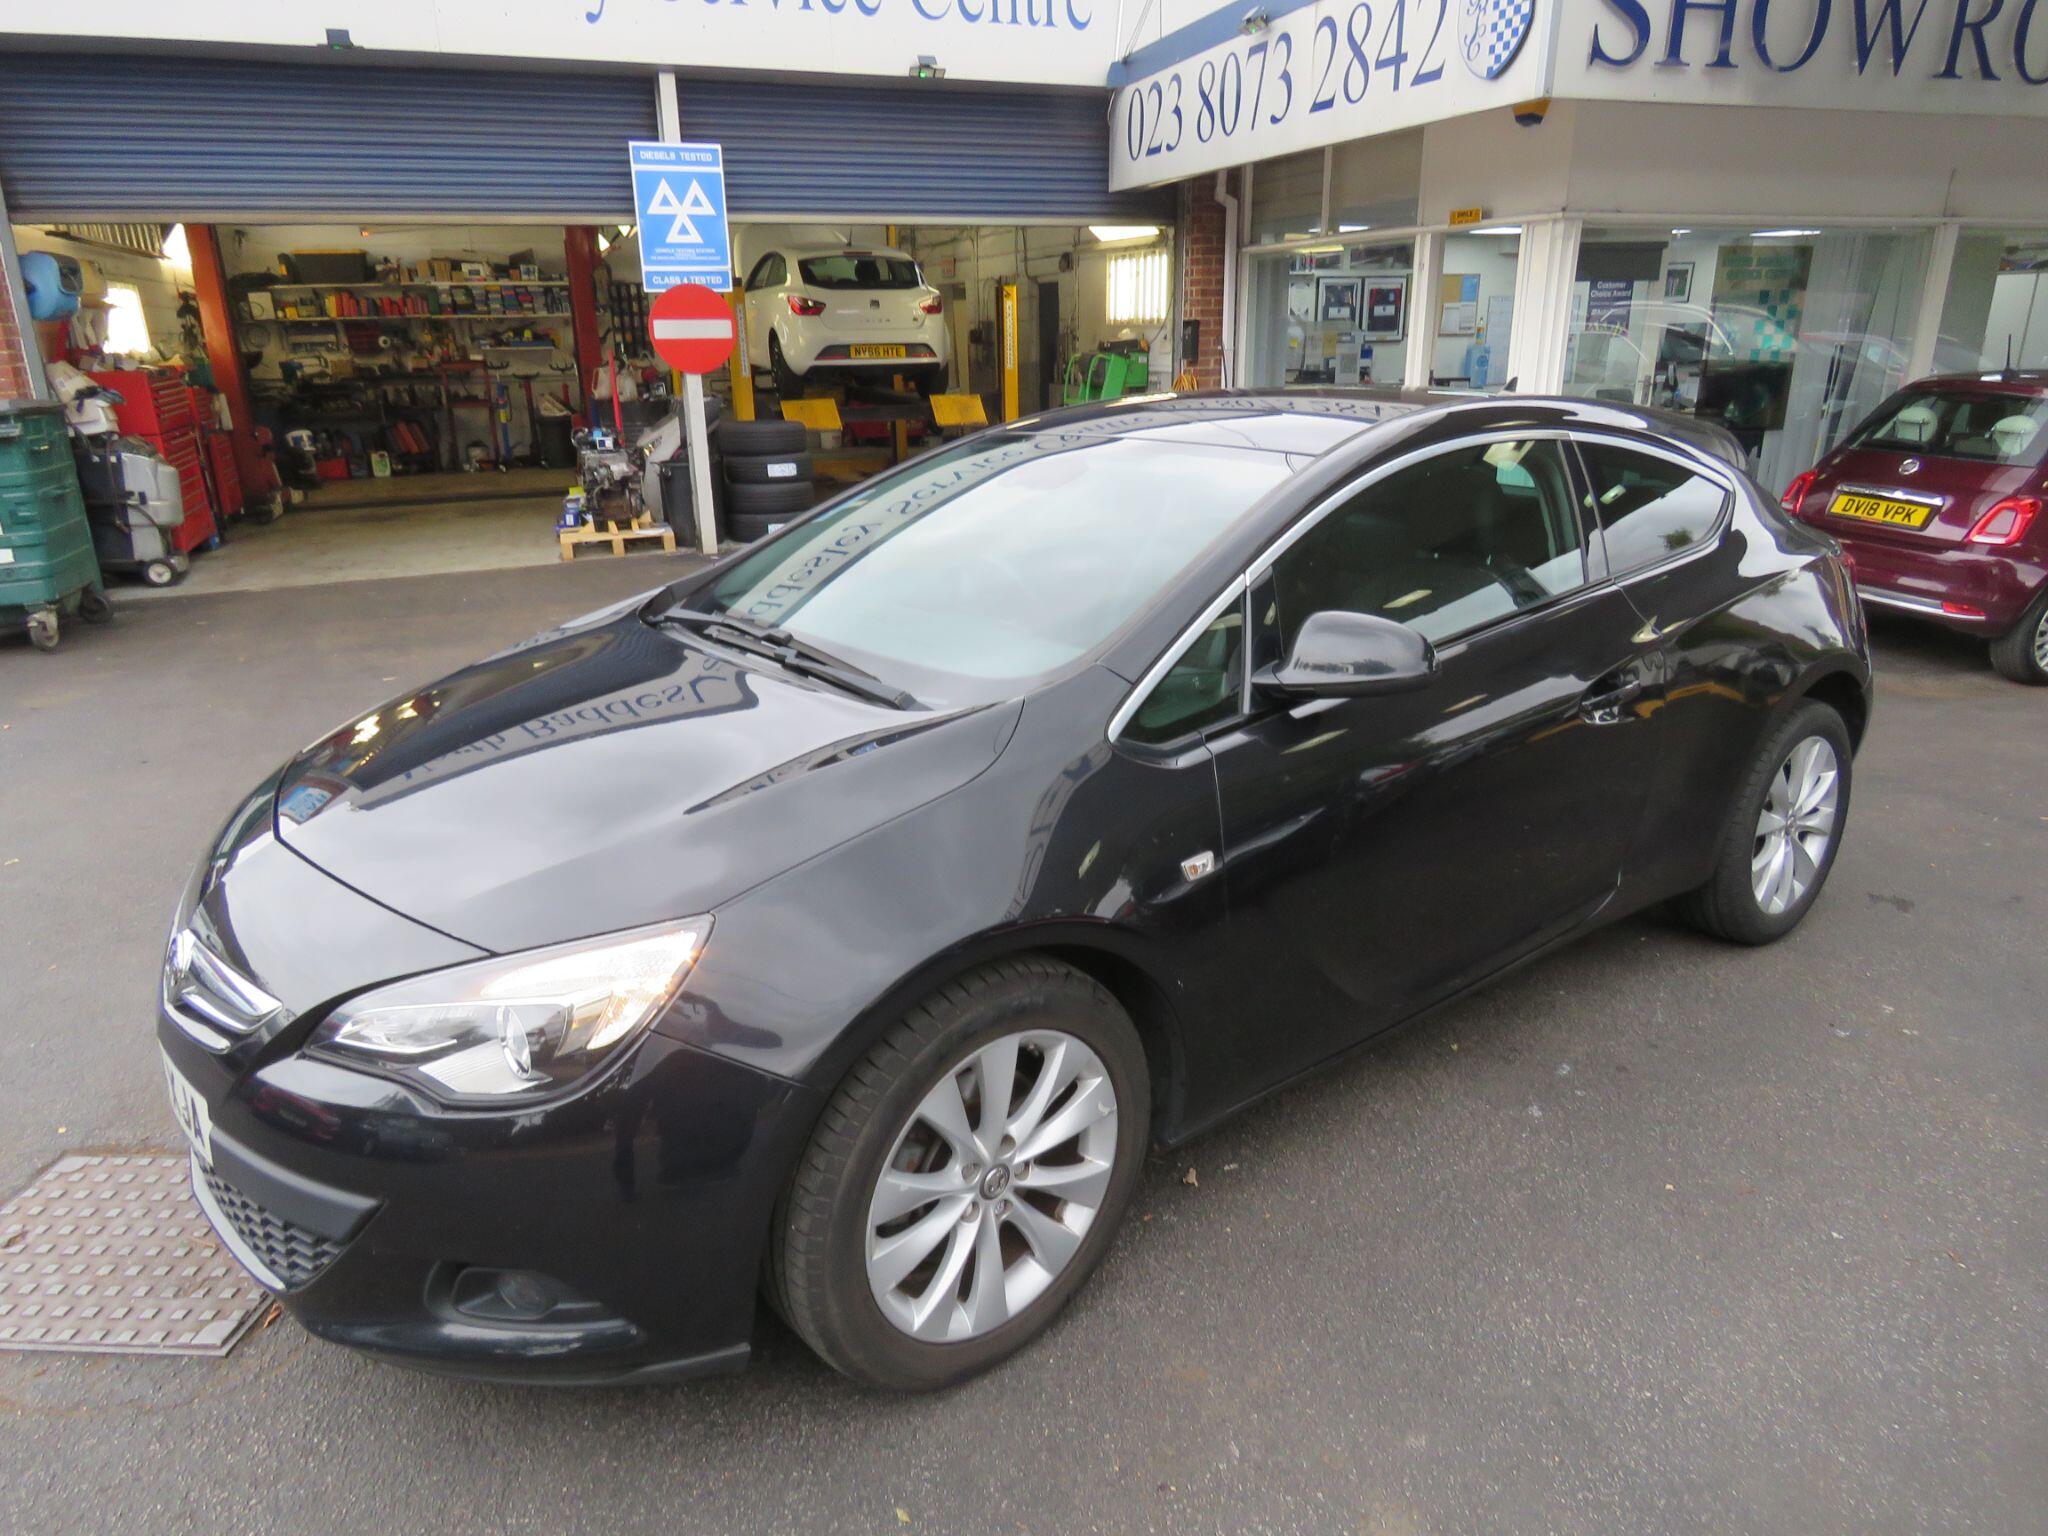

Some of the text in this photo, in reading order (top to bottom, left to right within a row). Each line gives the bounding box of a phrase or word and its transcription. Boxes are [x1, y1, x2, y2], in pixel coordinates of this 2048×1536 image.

[1127, 73, 1183, 161] 023
[1196, 32, 1293, 143] 8073
[1309, 0, 1446, 113] 2842
[639, 150, 713, 162] DIESELS TESTED
[653, 276, 681, 285] CLASS
[690, 276, 722, 284] TESTED
[1841, 498, 1919, 523] DV18 VPK
